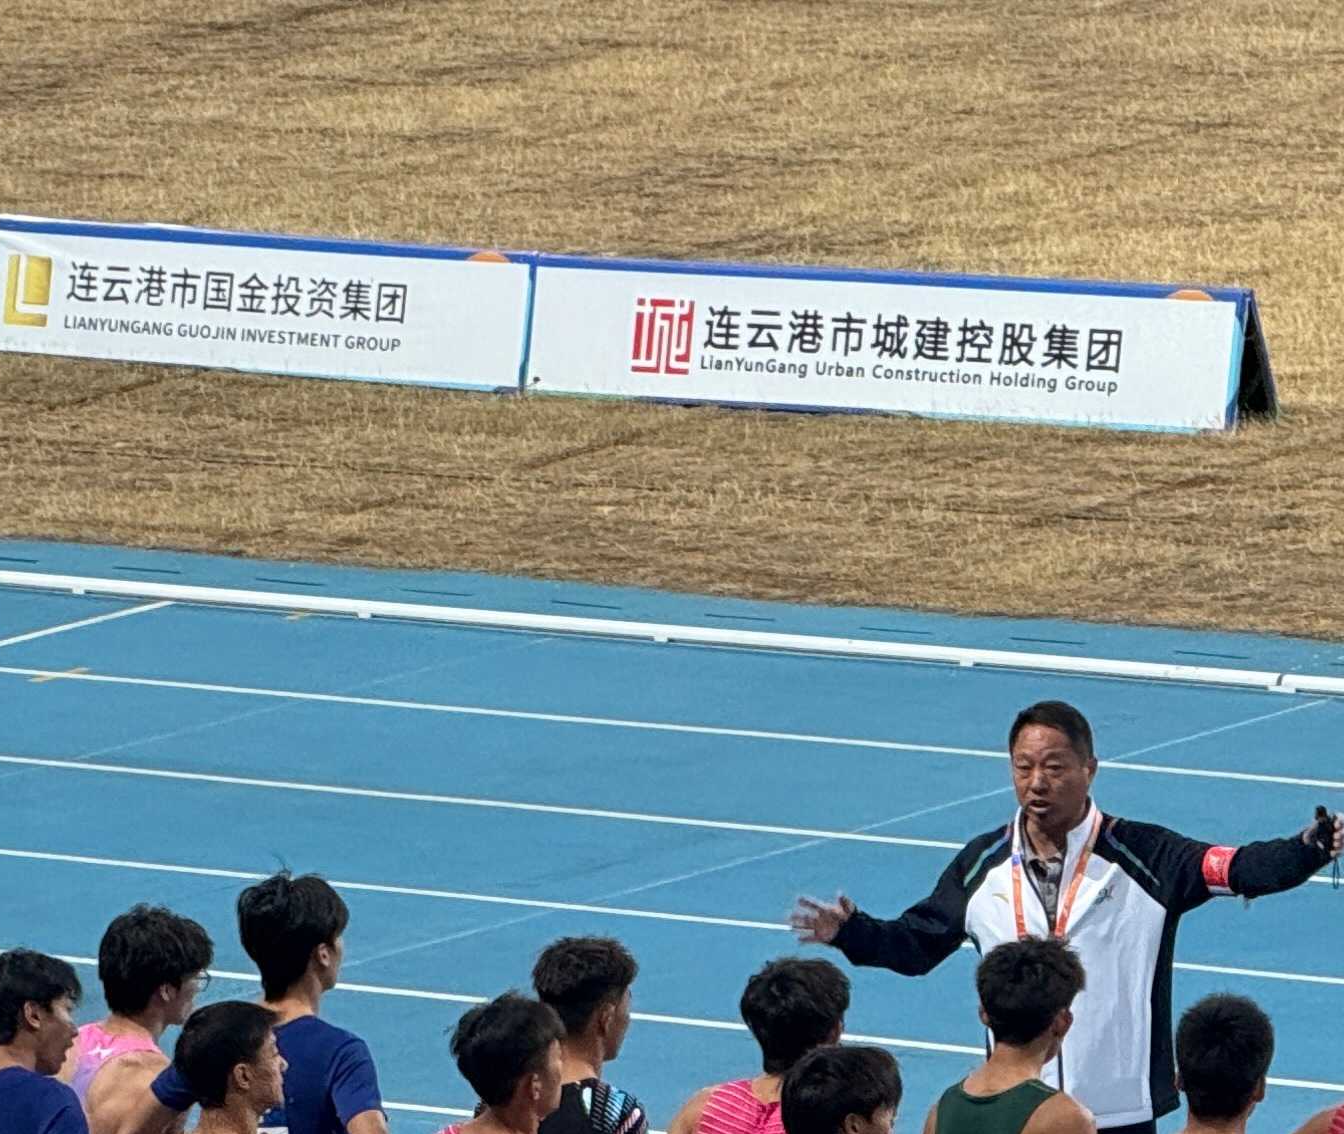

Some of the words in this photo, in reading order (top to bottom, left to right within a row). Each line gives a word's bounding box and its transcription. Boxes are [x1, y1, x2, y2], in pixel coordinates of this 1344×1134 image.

[66, 261, 408, 325] 连云港市国金投资集团
[64, 315, 173, 337] LIANYUNGANG
[177, 323, 237, 341] GUOJIN
[241, 328, 342, 349] INVESTMENT
[344, 335, 401, 352] GROUP
[703, 305, 1123, 374] 连云港市城建控股集团
[700, 355, 808, 379] LianYunGang
[815, 360, 865, 378] Urban
[872, 364, 982, 386] Construction
[989, 371, 1057, 393] Holding
[1065, 375, 1118, 396] Group
